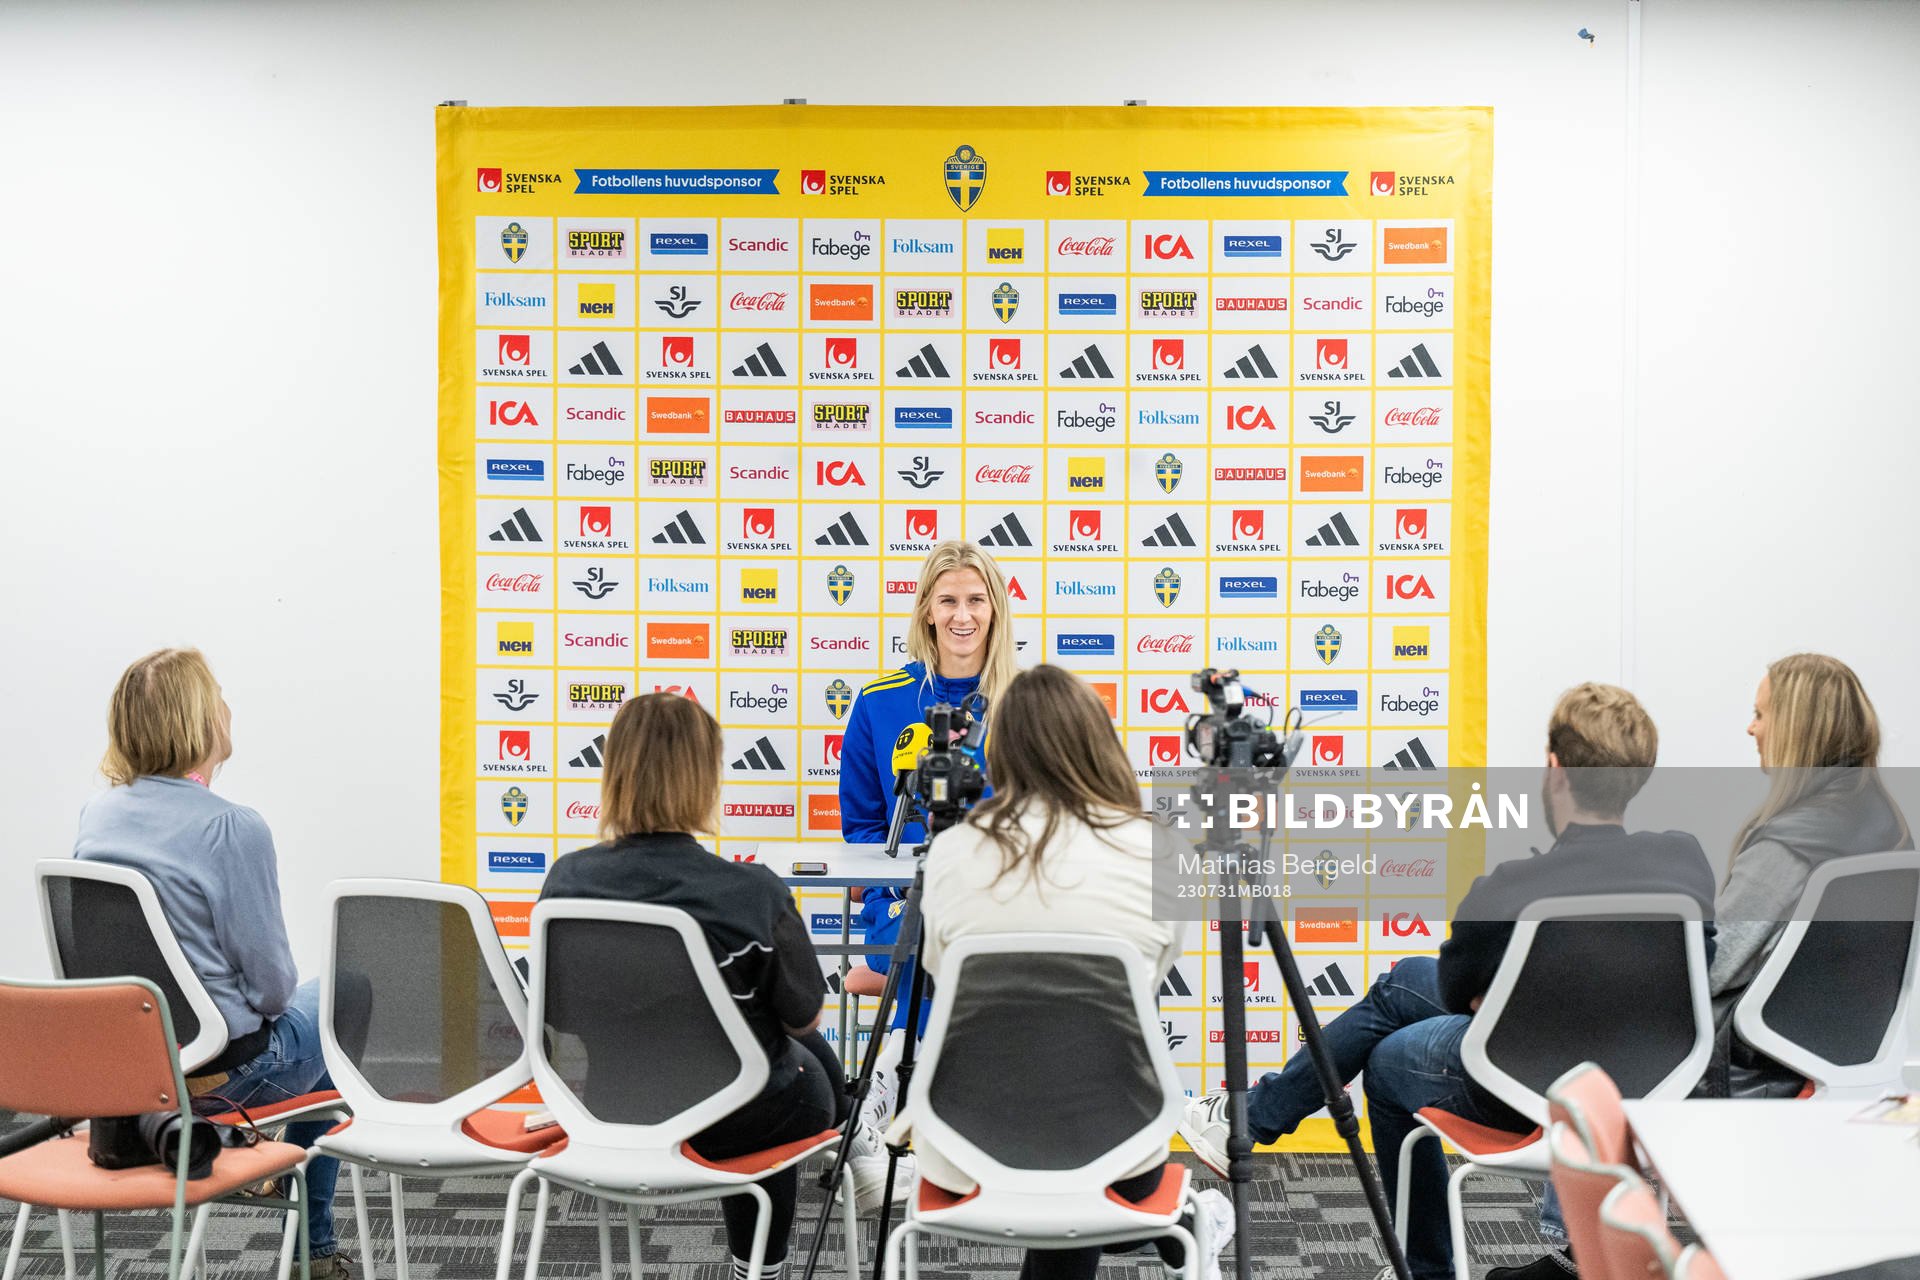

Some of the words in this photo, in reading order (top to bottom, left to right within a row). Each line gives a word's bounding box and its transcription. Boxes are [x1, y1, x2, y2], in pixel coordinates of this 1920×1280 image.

[506, 173, 562, 183] SVENSKA
[592, 175, 662, 187] Fotbollens
[665, 175, 762, 190] huvudsponsor
[830, 175, 885, 184] SVENSKA
[1075, 176, 1130, 185] SVENSKA
[1161, 177, 1231, 189] Fotbollens
[1234, 177, 1331, 192] huvudsponsor
[1400, 176, 1455, 185] SVENSKA
[506, 184, 535, 193] SPEL
[830, 186, 859, 195] SPEL
[1075, 187, 1104, 196] SPEL
[1400, 187, 1428, 196] SPEL
[569, 232, 624, 250] SPORT
[1326, 228, 1342, 244] SJ
[729, 238, 788, 251] Scandic
[813, 238, 870, 260] Fabege
[893, 239, 953, 253] Folksam
[1058, 237, 1116, 256] Coca-Cola
[1144, 234, 1194, 259] ICA
[1389, 241, 1430, 250] Swedbank
[485, 292, 546, 306] Folksam
[670, 286, 686, 301] SJ
[897, 291, 952, 309] SPORT
[730, 292, 788, 310] Coca-Cola
[815, 298, 856, 306] Swedbank
[1142, 292, 1196, 310] SPORT
[1217, 299, 1286, 309] BAUHAUS
[1303, 297, 1362, 310] Scandic
[1386, 295, 1444, 317] Fabege
[483, 369, 523, 377] SVENSKA
[646, 371, 687, 379] SVENSKA
[809, 372, 850, 380] SVENSKA
[973, 373, 1014, 381] SVENSKA
[1300, 373, 1341, 381] SVENSKA
[490, 401, 539, 426] ICA
[566, 407, 626, 420] Scandic
[652, 411, 692, 419] Swedbank
[814, 404, 869, 423] SPORT
[1324, 401, 1340, 416] SJ
[726, 411, 795, 421] BAUHAUS
[975, 411, 1034, 424] Scandic
[1058, 410, 1115, 432] Fabege
[1139, 410, 1199, 424] Folksam
[1227, 405, 1276, 430] ICA
[1385, 407, 1443, 426] Coca-Cola
[651, 460, 706, 478] SPORT
[913, 456, 929, 471] SJ
[567, 464, 624, 486] Fabege
[730, 466, 789, 479] Scandic
[817, 461, 866, 486] ICA
[976, 464, 1034, 483] Coca-Cola
[1216, 469, 1285, 479] BAUHAUS
[1306, 470, 1346, 478] Swedbank
[1385, 466, 1442, 488] Fabege
[564, 540, 605, 548] SVENSKA
[727, 542, 768, 550] SVENSKA
[1053, 544, 1094, 552] SVENSKA
[1216, 544, 1257, 552] SVENSKA
[1380, 543, 1420, 551] SVENSKA
[588, 567, 603, 582] SJ
[486, 573, 544, 592] Coca-Cola
[648, 578, 709, 592] Folksam
[1056, 581, 1116, 595] Folksam
[1386, 574, 1435, 599] ICA
[1301, 580, 1359, 602] Fabege
[565, 633, 628, 647] Scandic
[652, 636, 692, 645] Swedbank
[732, 630, 787, 648] SPORT
[810, 637, 870, 649] Scandic
[1137, 634, 1195, 653] Coca-Cola
[1217, 637, 1277, 651] Folksam
[508, 679, 524, 694] SJ
[570, 684, 624, 702] SPORT
[730, 691, 788, 713] Fabege
[1141, 688, 1190, 713] ICA
[1381, 694, 1439, 716] Fabege
[483, 764, 524, 772] SVENSKA
[725, 805, 794, 815] BAUHAUS
[1300, 921, 1340, 929] Swedbank
[1382, 912, 1431, 937] ICA
